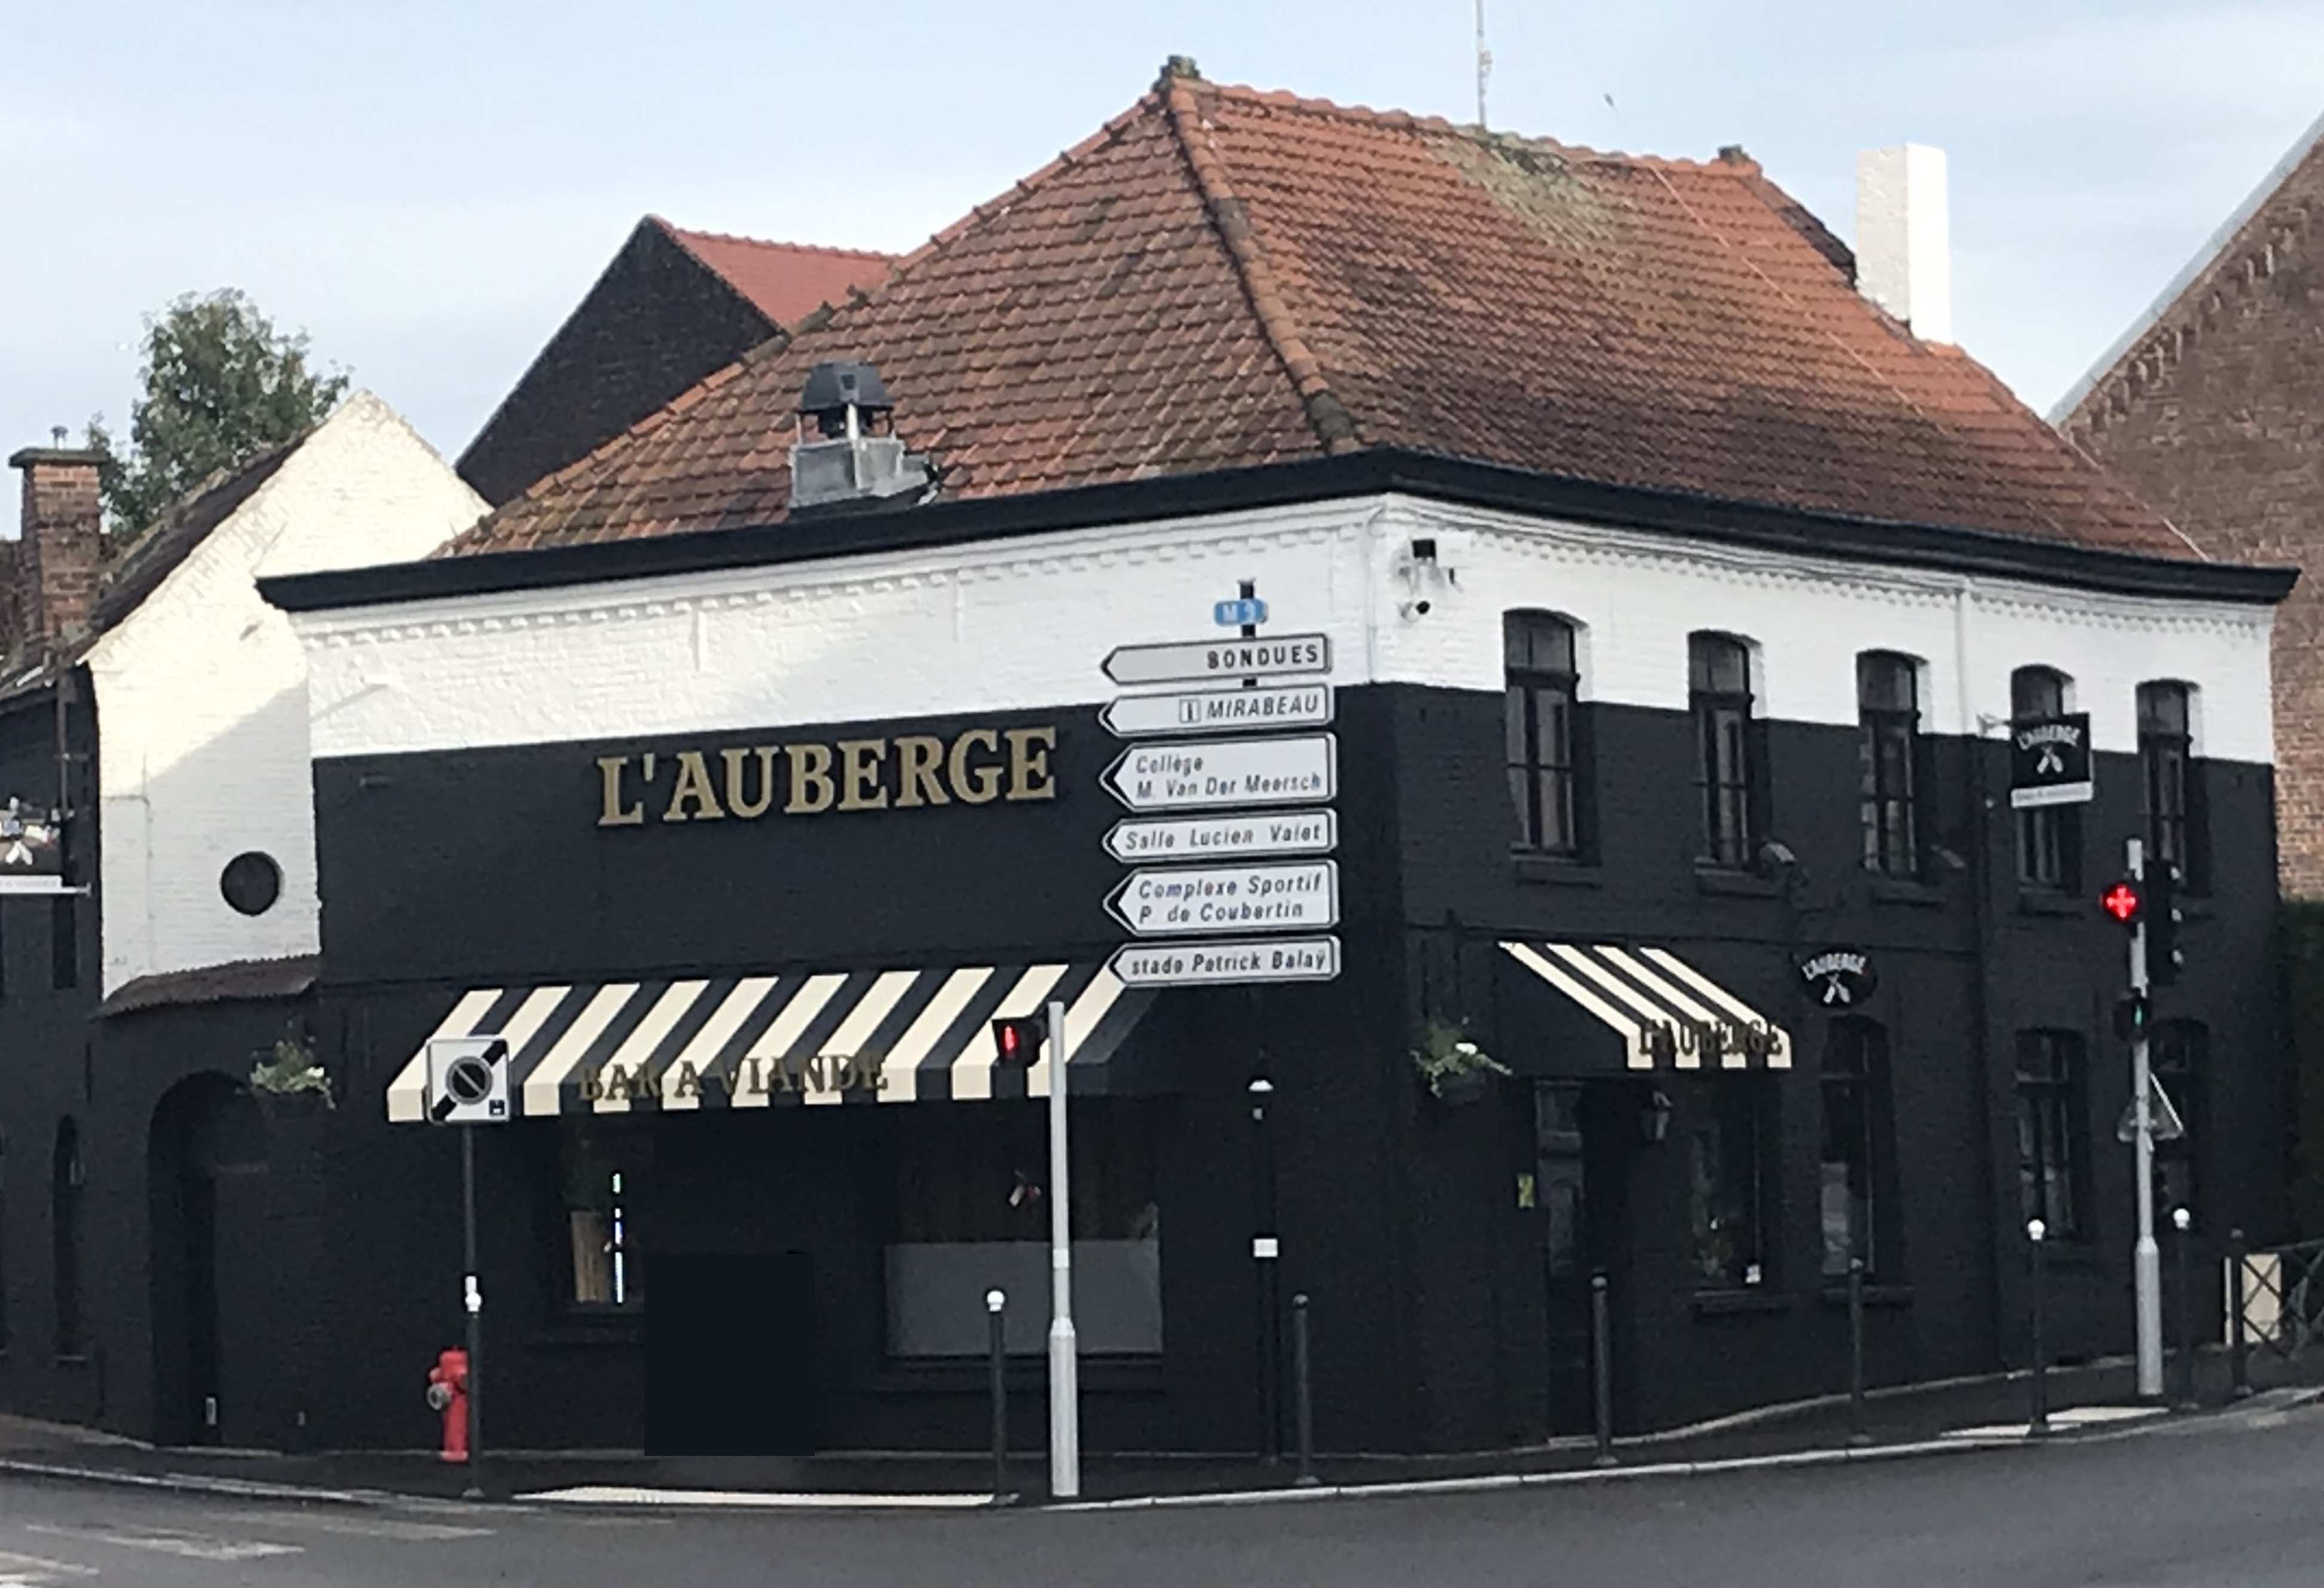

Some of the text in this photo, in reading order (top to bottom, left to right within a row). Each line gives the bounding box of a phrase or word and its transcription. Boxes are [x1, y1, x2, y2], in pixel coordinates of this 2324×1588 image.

[1207, 645, 1318, 669] BONDUES
[1207, 694, 1319, 719] MIRABEAU
[598, 726, 1056, 826] L'AUBERGE
[1166, 779, 1197, 798] Van
[1205, 777, 1236, 796] Der
[1244, 772, 1320, 793] Meersch
[1126, 823, 1320, 851] Salle Lucien Valet
[1139, 872, 1322, 902] Complexe Sportif
[1167, 905, 1191, 923] de
[1200, 901, 1304, 922] Coubertin
[1192, 952, 1261, 973] Patrick
[580, 1062, 665, 1101] BAR
[717, 1052, 888, 1095] VIANDE
